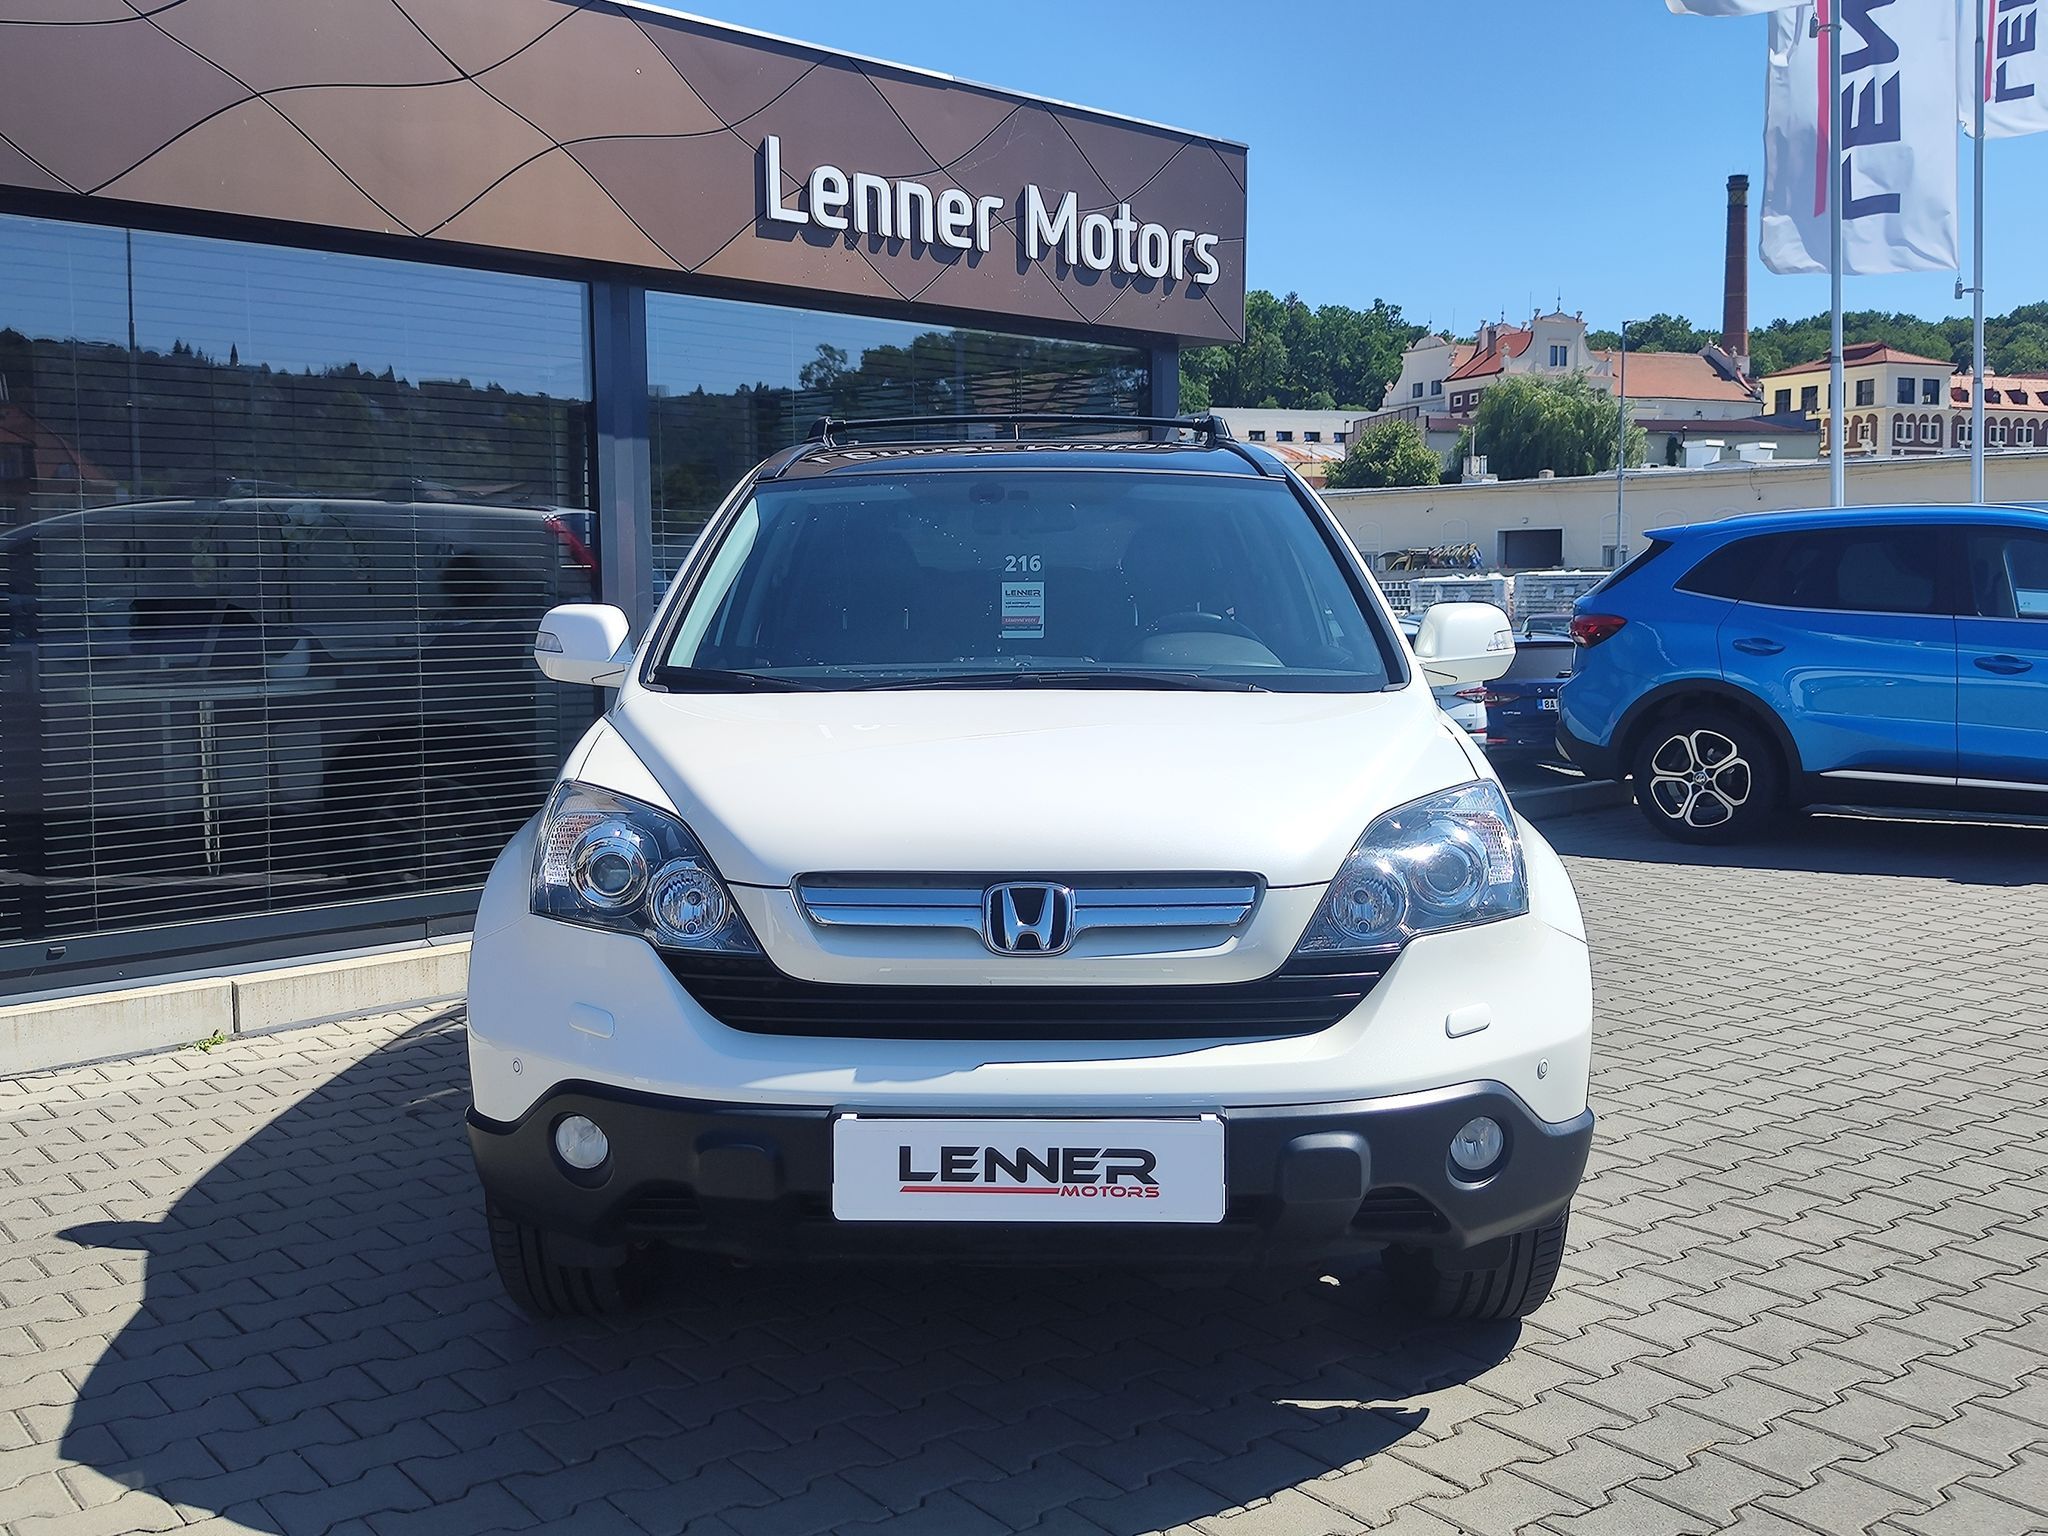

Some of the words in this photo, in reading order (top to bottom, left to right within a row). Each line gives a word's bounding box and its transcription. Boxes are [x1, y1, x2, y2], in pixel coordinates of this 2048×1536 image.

[764, 135, 1004, 253] Lenner
[1024, 183, 1220, 286] Motors
[1004, 554, 1042, 573] 216
[1004, 589, 1042, 598] LENNER
[899, 1145, 1160, 1185] LENNER
[1060, 1184, 1160, 1199] MOTORS
